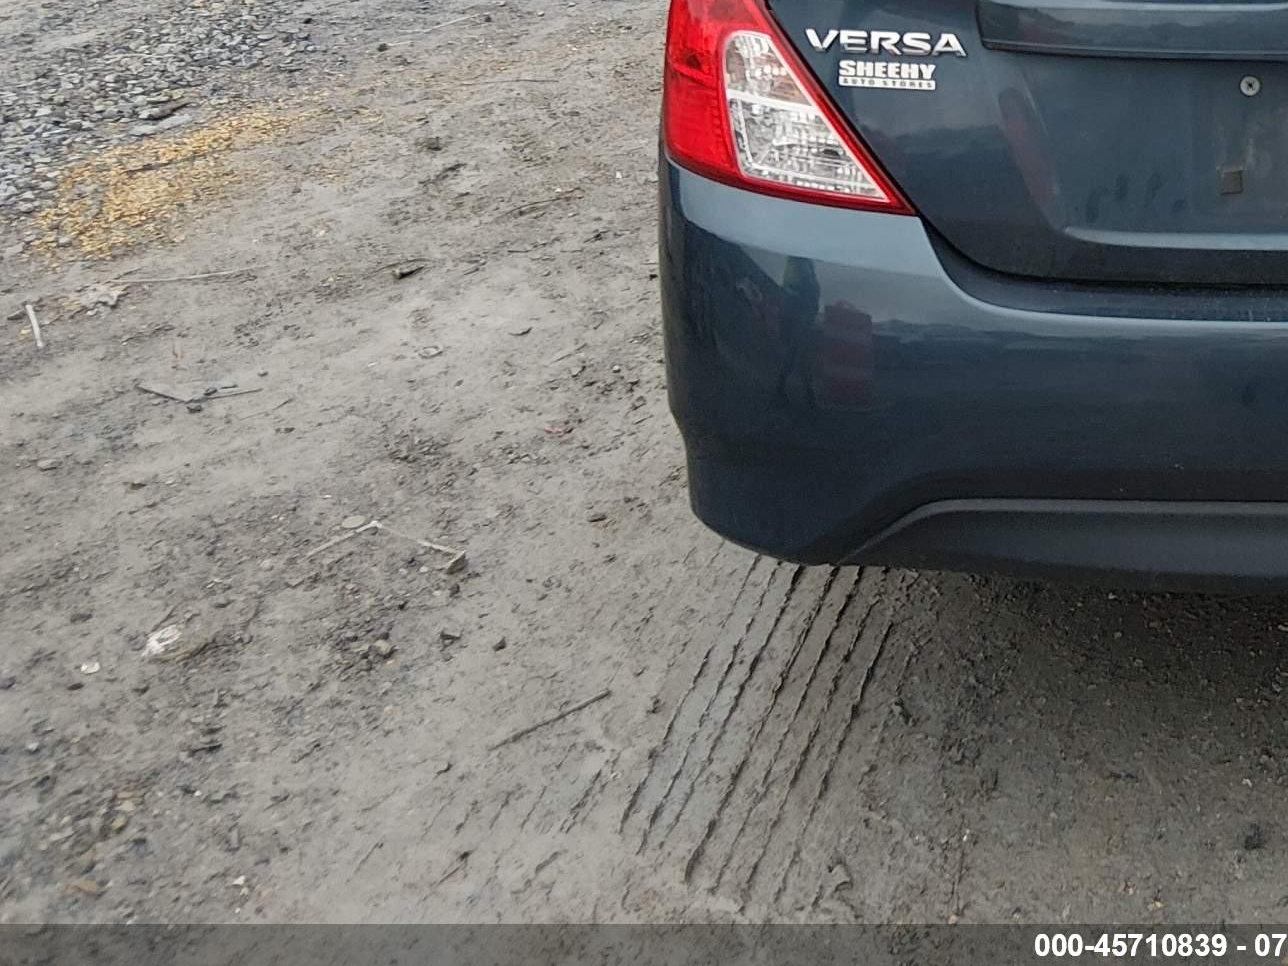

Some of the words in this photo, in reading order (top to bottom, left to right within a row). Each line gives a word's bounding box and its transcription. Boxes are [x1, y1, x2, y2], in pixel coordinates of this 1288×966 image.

[805, 28, 967, 57] VERSA
[838, 60, 937, 80] SHEEHY
[843, 77, 875, 86] AUTO
